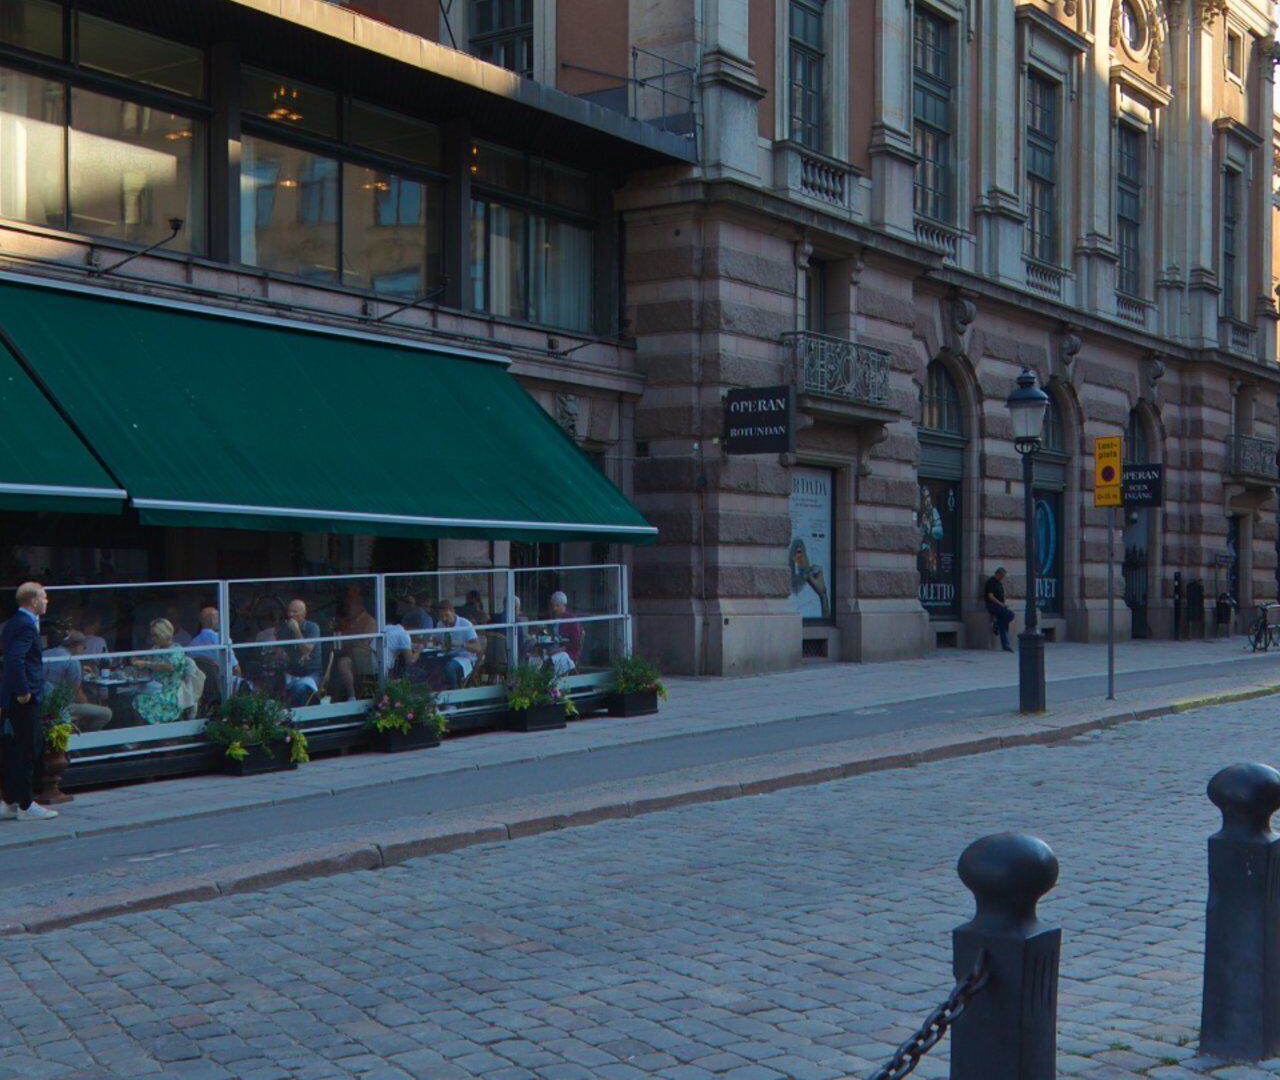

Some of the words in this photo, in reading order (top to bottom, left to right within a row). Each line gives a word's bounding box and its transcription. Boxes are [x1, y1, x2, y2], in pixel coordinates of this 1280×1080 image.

[730, 398, 786, 413] OPERAN
[730, 425, 786, 438] ROTUNDAN
[1098, 451, 1117, 459] plats
